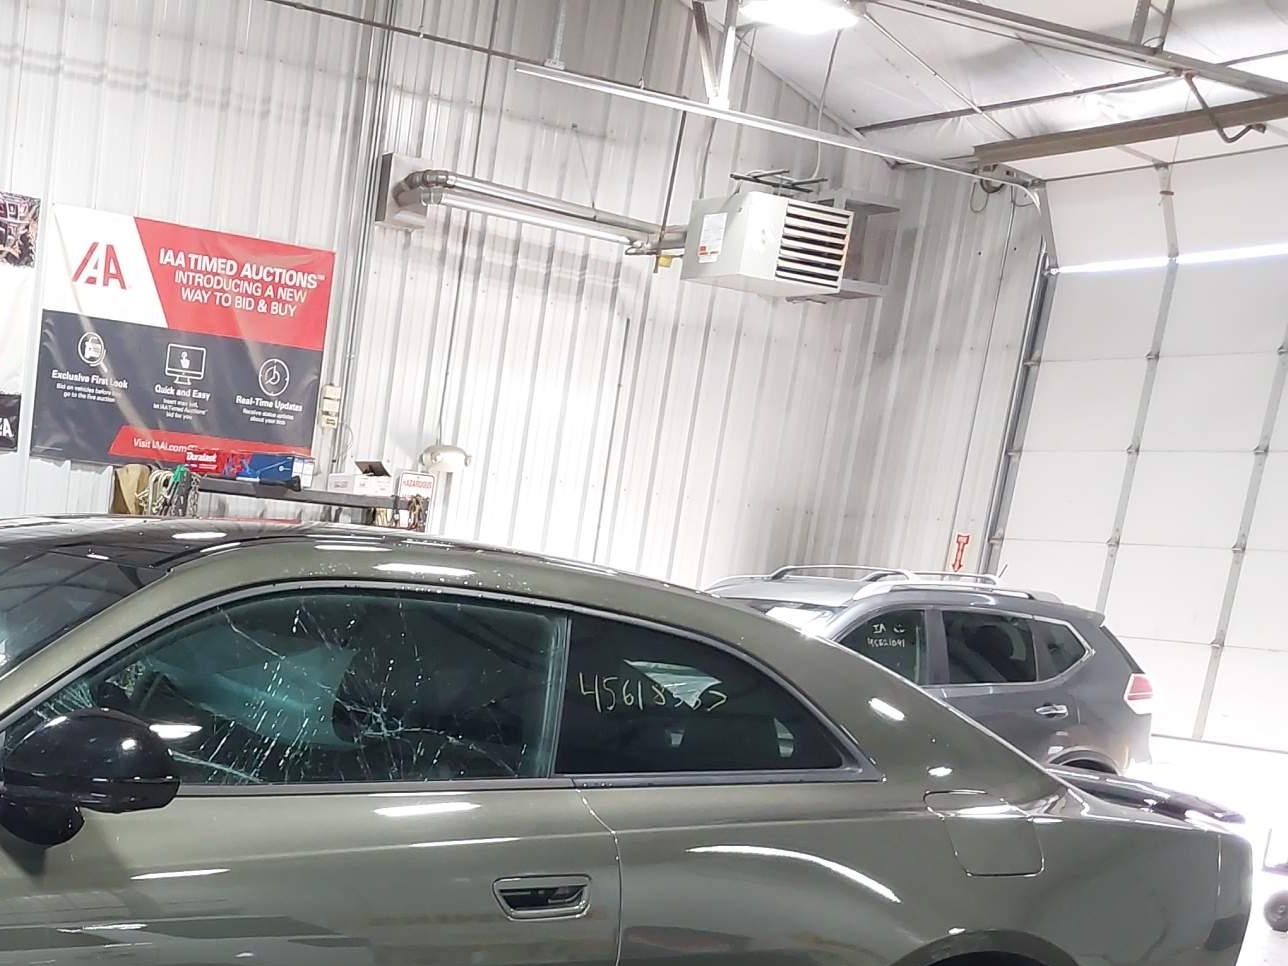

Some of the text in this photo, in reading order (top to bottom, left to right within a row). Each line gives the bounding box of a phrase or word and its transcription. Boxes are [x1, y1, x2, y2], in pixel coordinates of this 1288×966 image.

[159, 248, 186, 268] IAA
[188, 253, 237, 276] TIMED
[175, 270, 307, 304] INTRODUCING A NEW
[181, 287, 297, 317] WAY TO BID & BUY
[52, 369, 128, 389] Exclusive First Look
[154, 384, 211, 401] Quick and Easy
[236, 395, 303, 411] Real-Time Updates
[133, 437, 150, 449] Visit
